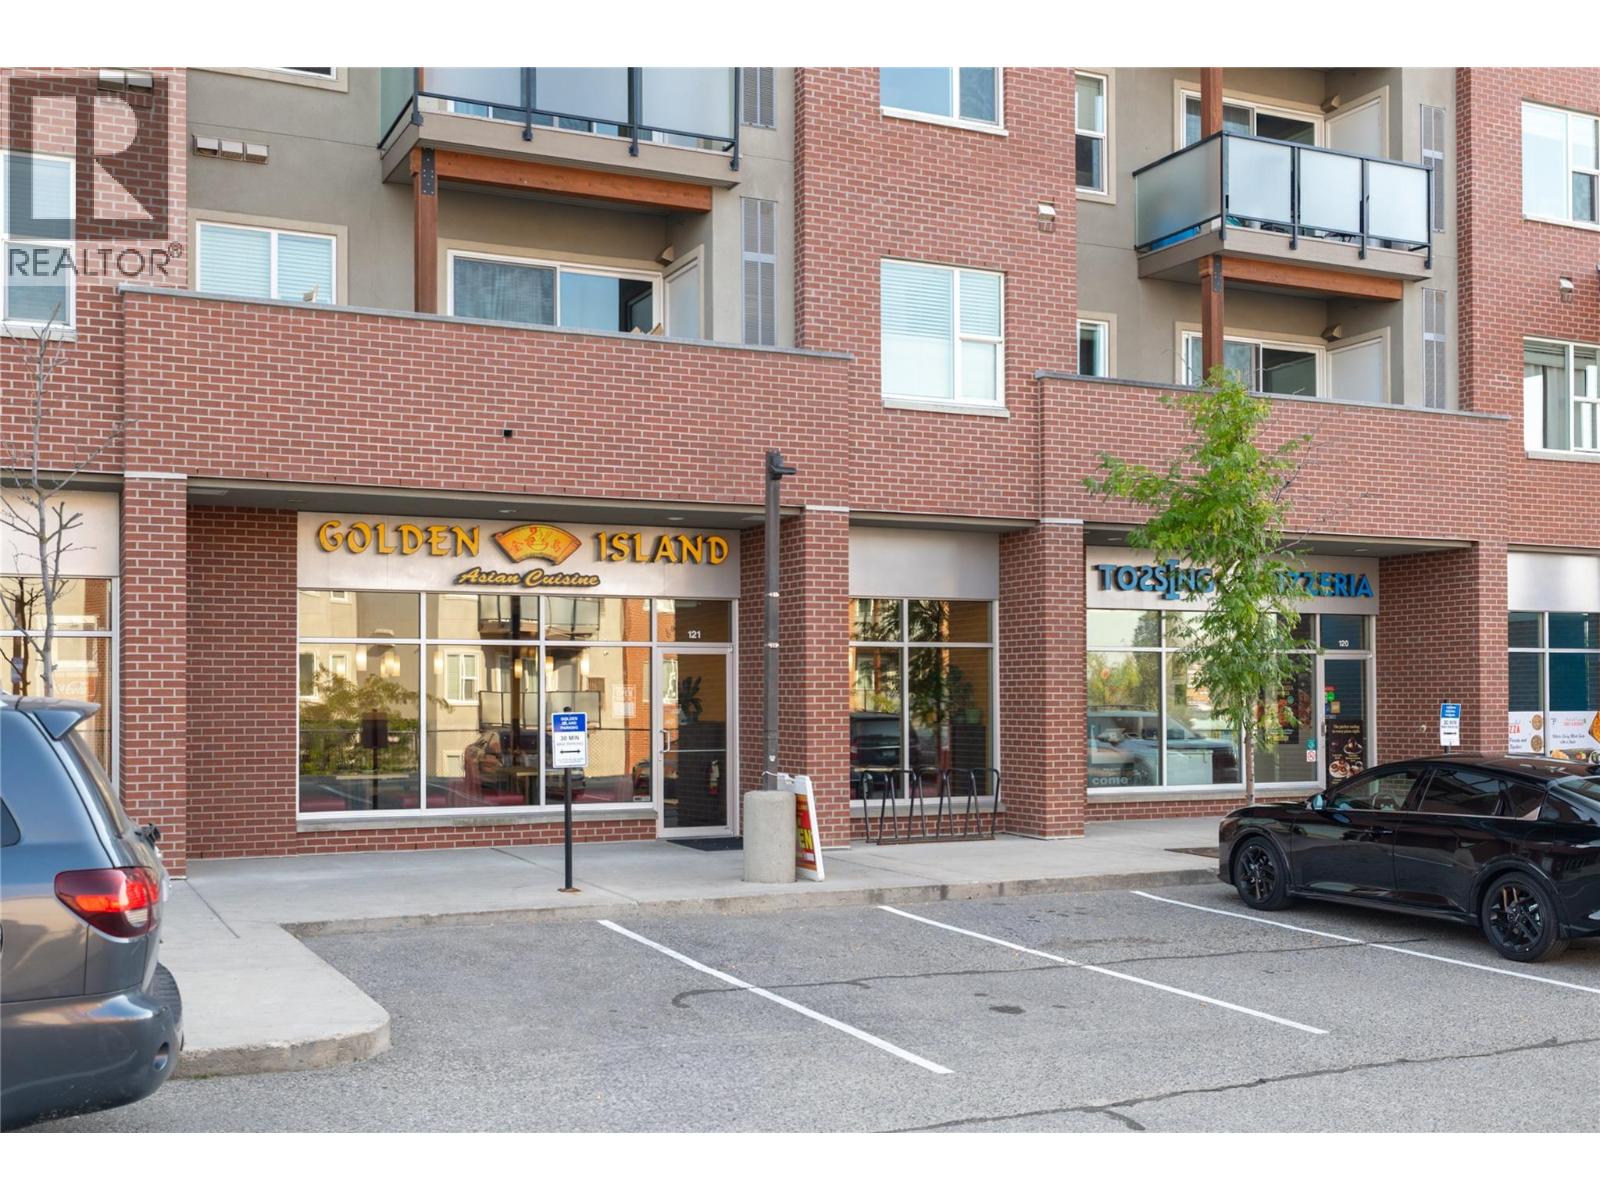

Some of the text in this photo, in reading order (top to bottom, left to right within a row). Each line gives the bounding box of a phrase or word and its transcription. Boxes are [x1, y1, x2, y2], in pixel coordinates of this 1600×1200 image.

[317, 520, 481, 557] GOLDEN
[597, 531, 730, 565] ISLAND
[457, 566, 600, 588] Asian Cuisine
[687, 630, 701, 639] 121
[1338, 639, 1350, 648] 120
[1509, 724, 1521, 734] ZZA
